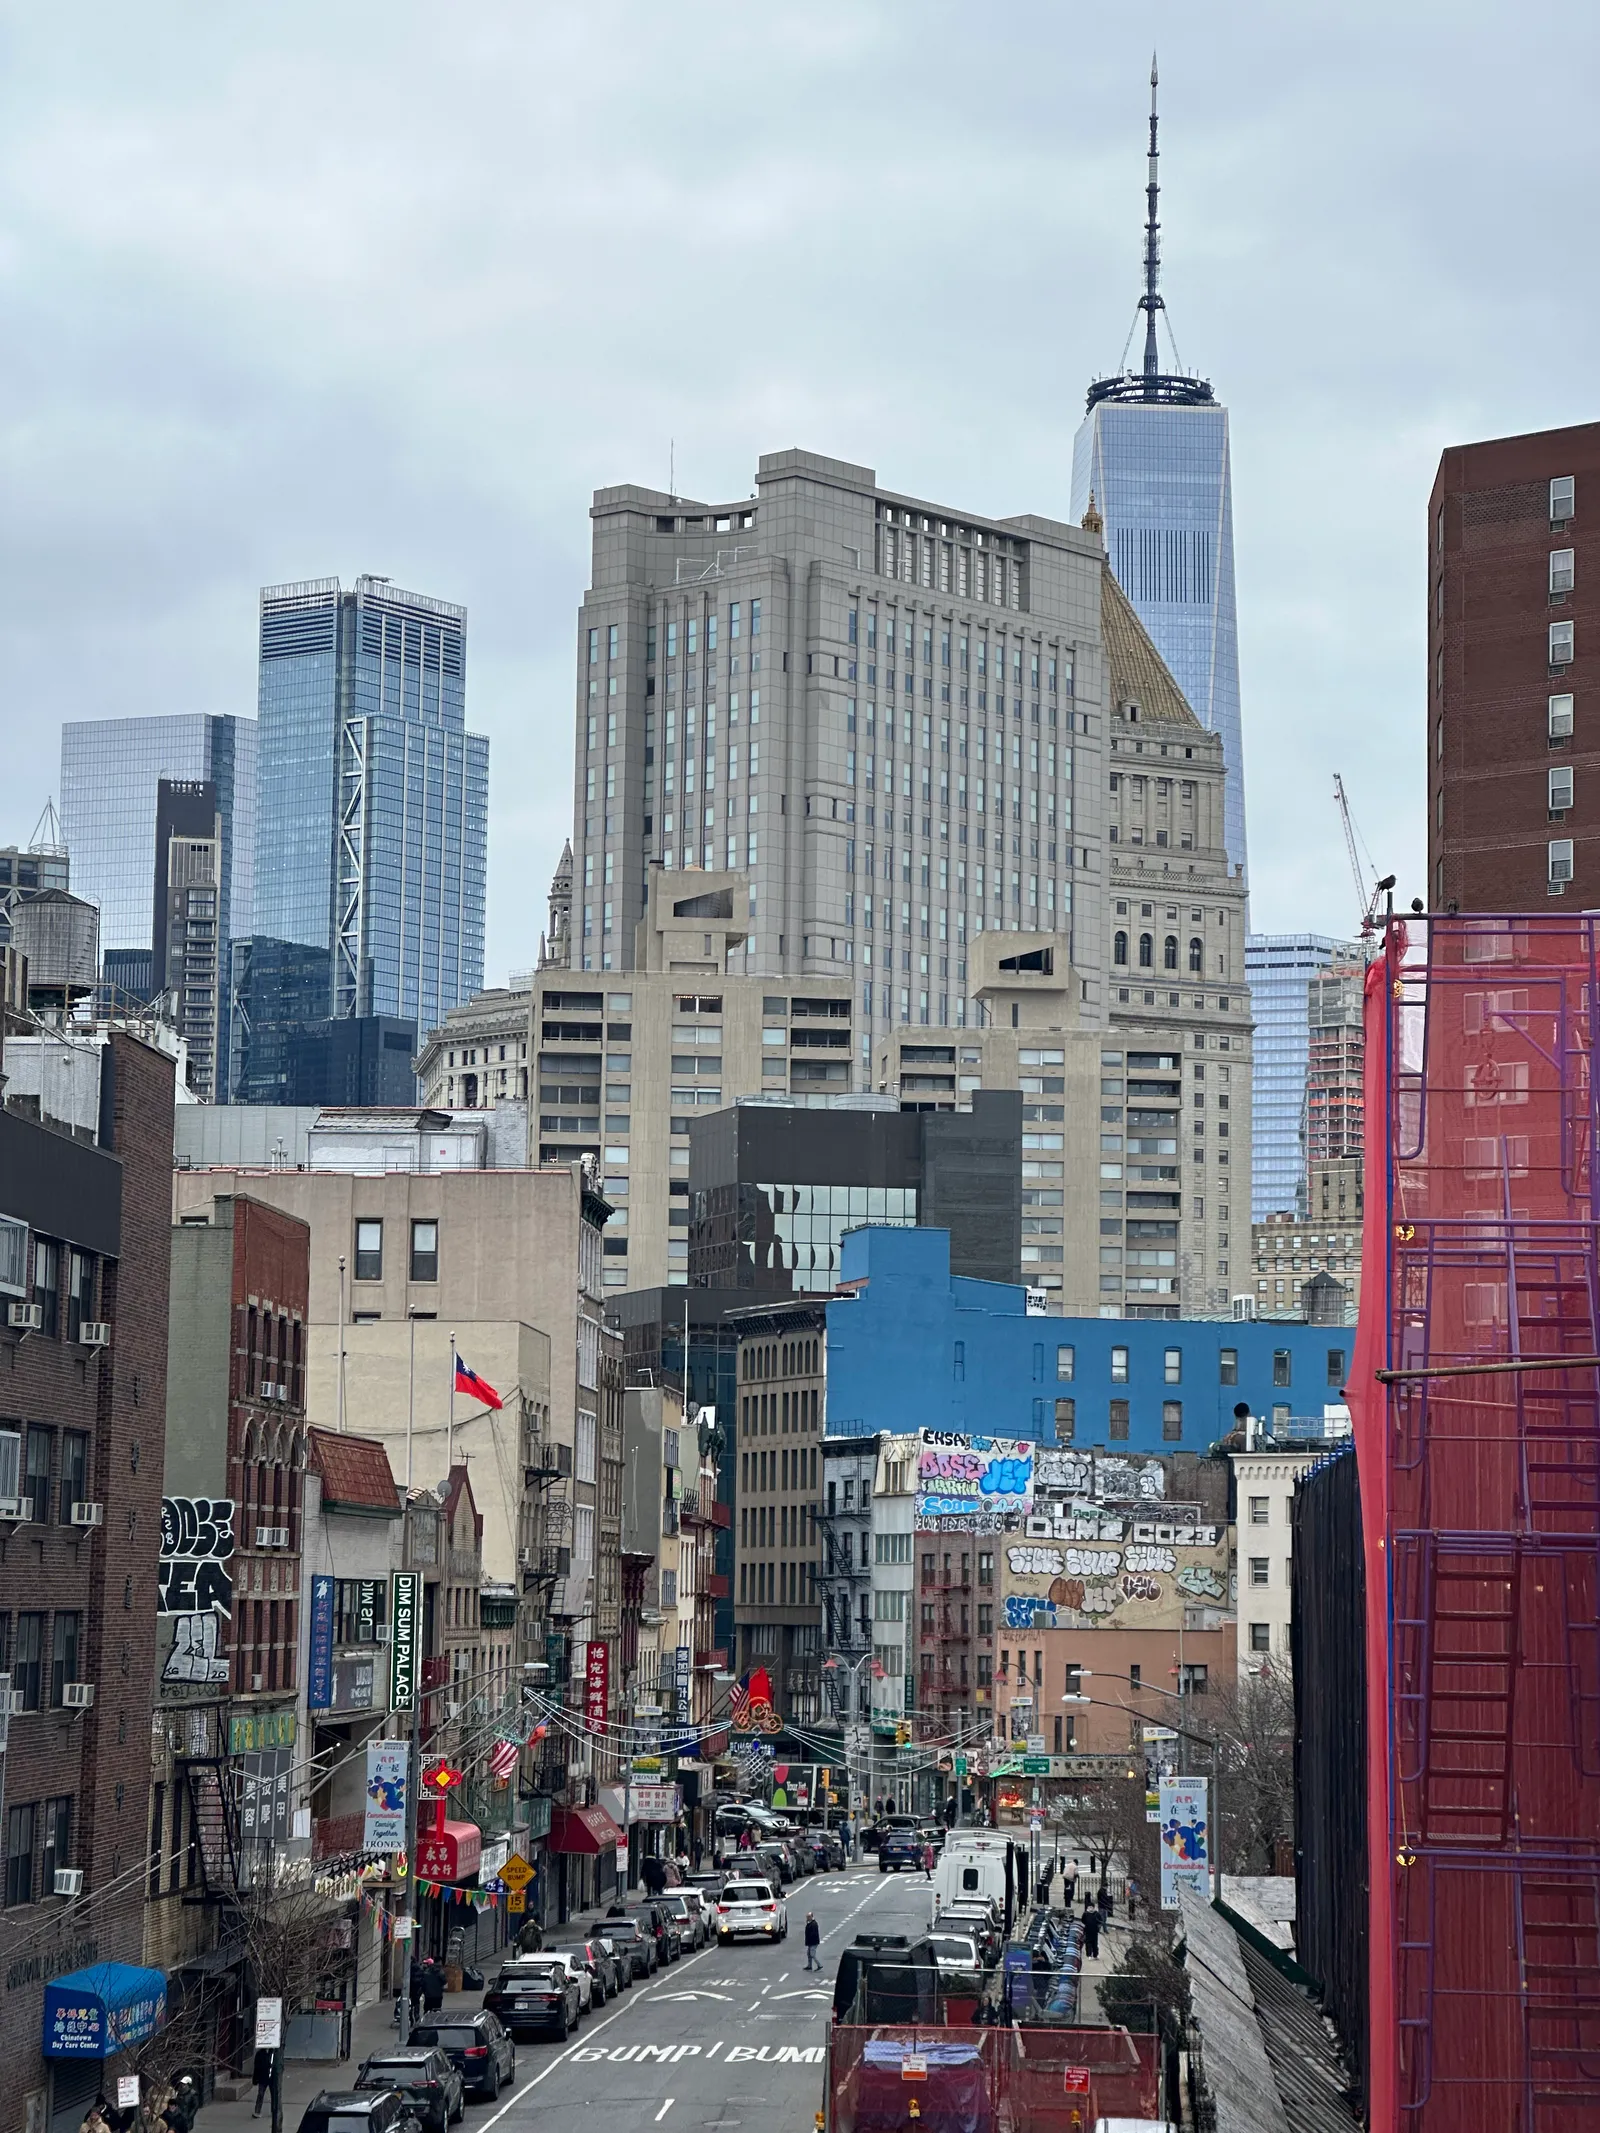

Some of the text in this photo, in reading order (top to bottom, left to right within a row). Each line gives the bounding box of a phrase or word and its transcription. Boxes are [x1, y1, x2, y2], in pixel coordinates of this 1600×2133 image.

[395, 1577, 412, 1706] DIM SUM PALACE
[375, 1763, 400, 1773] 在一起
[276, 1775, 287, 1822] 美甲
[1171, 1805, 1198, 1815] 在一起
[374, 1820, 397, 1830] Coming
[372, 1829, 399, 1839] Together
[365, 1840, 403, 1848] TRONEX
[426, 1846, 448, 1861] 永昌
[420, 1864, 452, 1876] 五金行
[510, 1895, 522, 1906] 15
[52, 2041, 100, 2050] Day Care Center
[570, 2045, 703, 2063] BUMP
